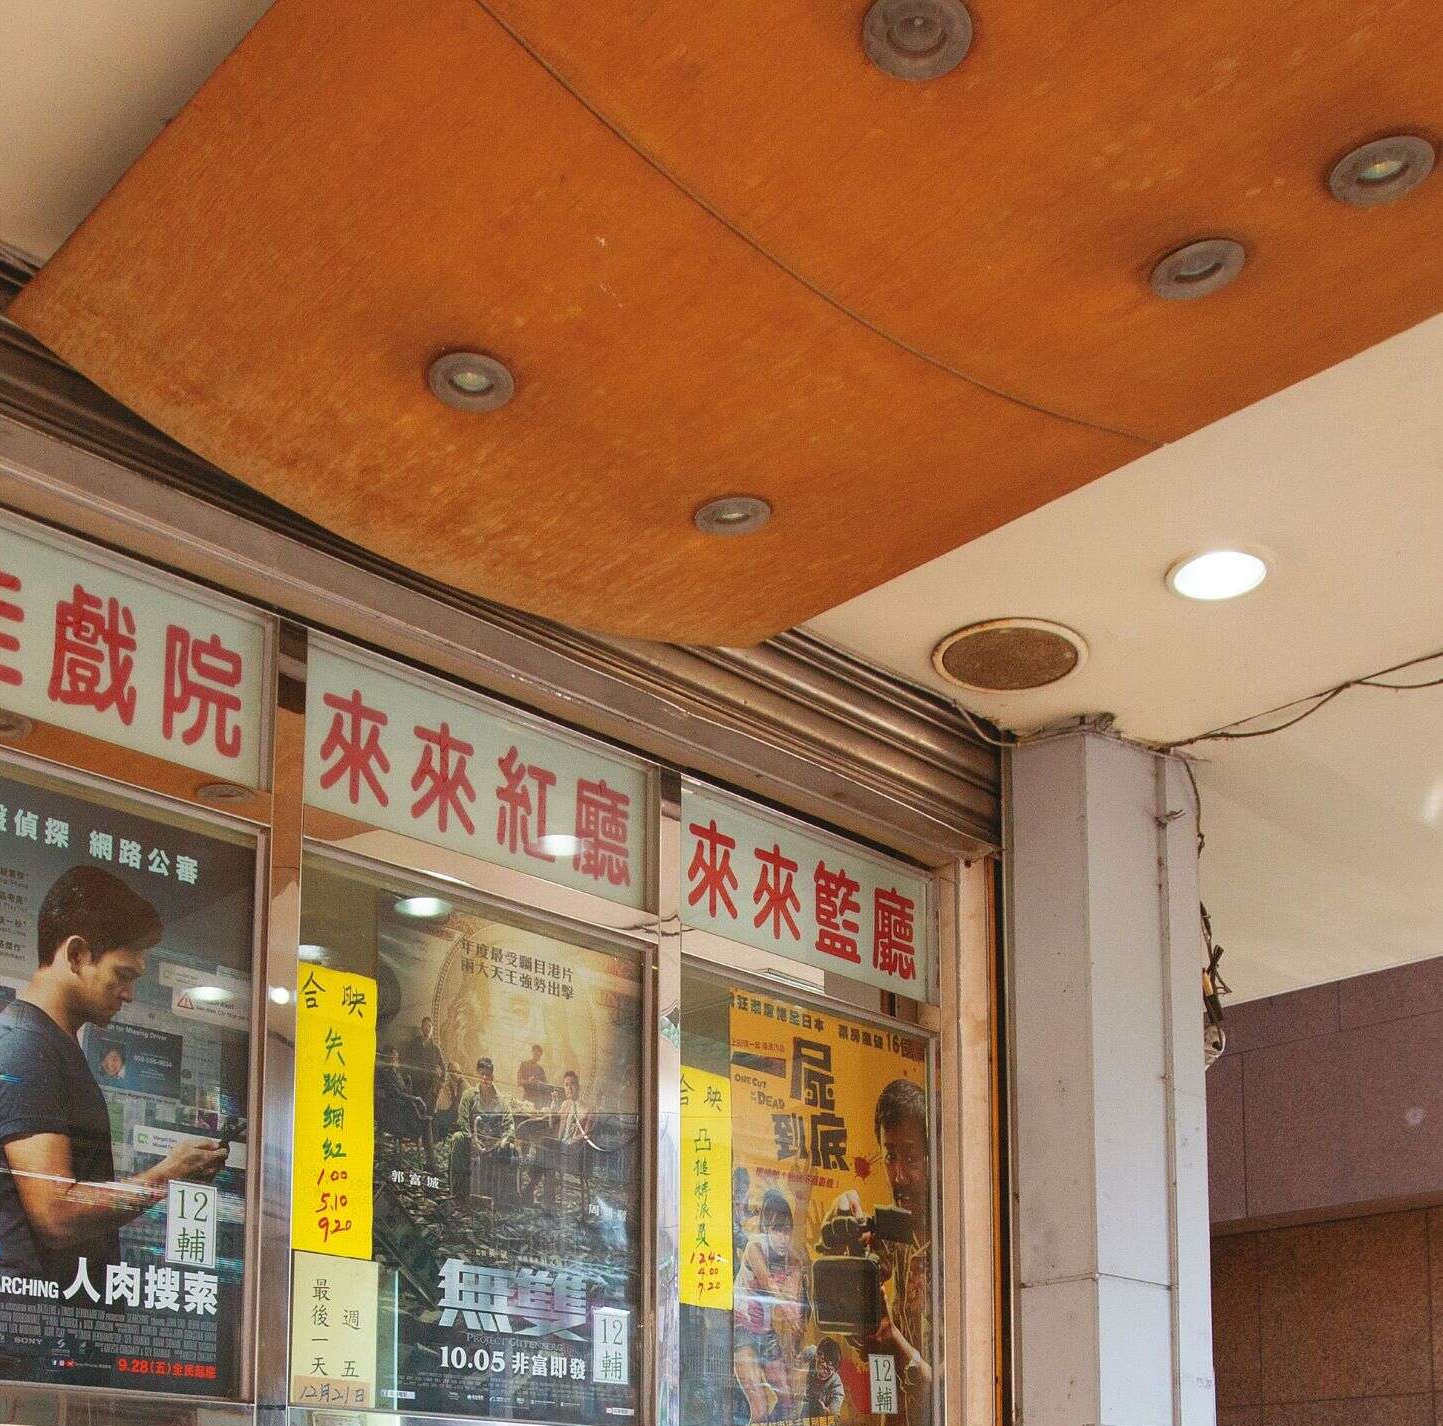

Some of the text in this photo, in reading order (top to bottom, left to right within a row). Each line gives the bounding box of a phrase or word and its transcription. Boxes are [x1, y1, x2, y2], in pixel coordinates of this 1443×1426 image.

[321, 689, 632, 888] 來來紅廳
[90, 831, 198, 884] 網路公審
[462, 936, 573, 983] 年度最受矚目港片
[462, 957, 574, 1000] 兩大天王強勢出擊
[391, 1170, 440, 1190] 郭富城
[62, 1257, 218, 1315] 人肉搜索
[440, 1346, 586, 1381] 10.05 非富即發
